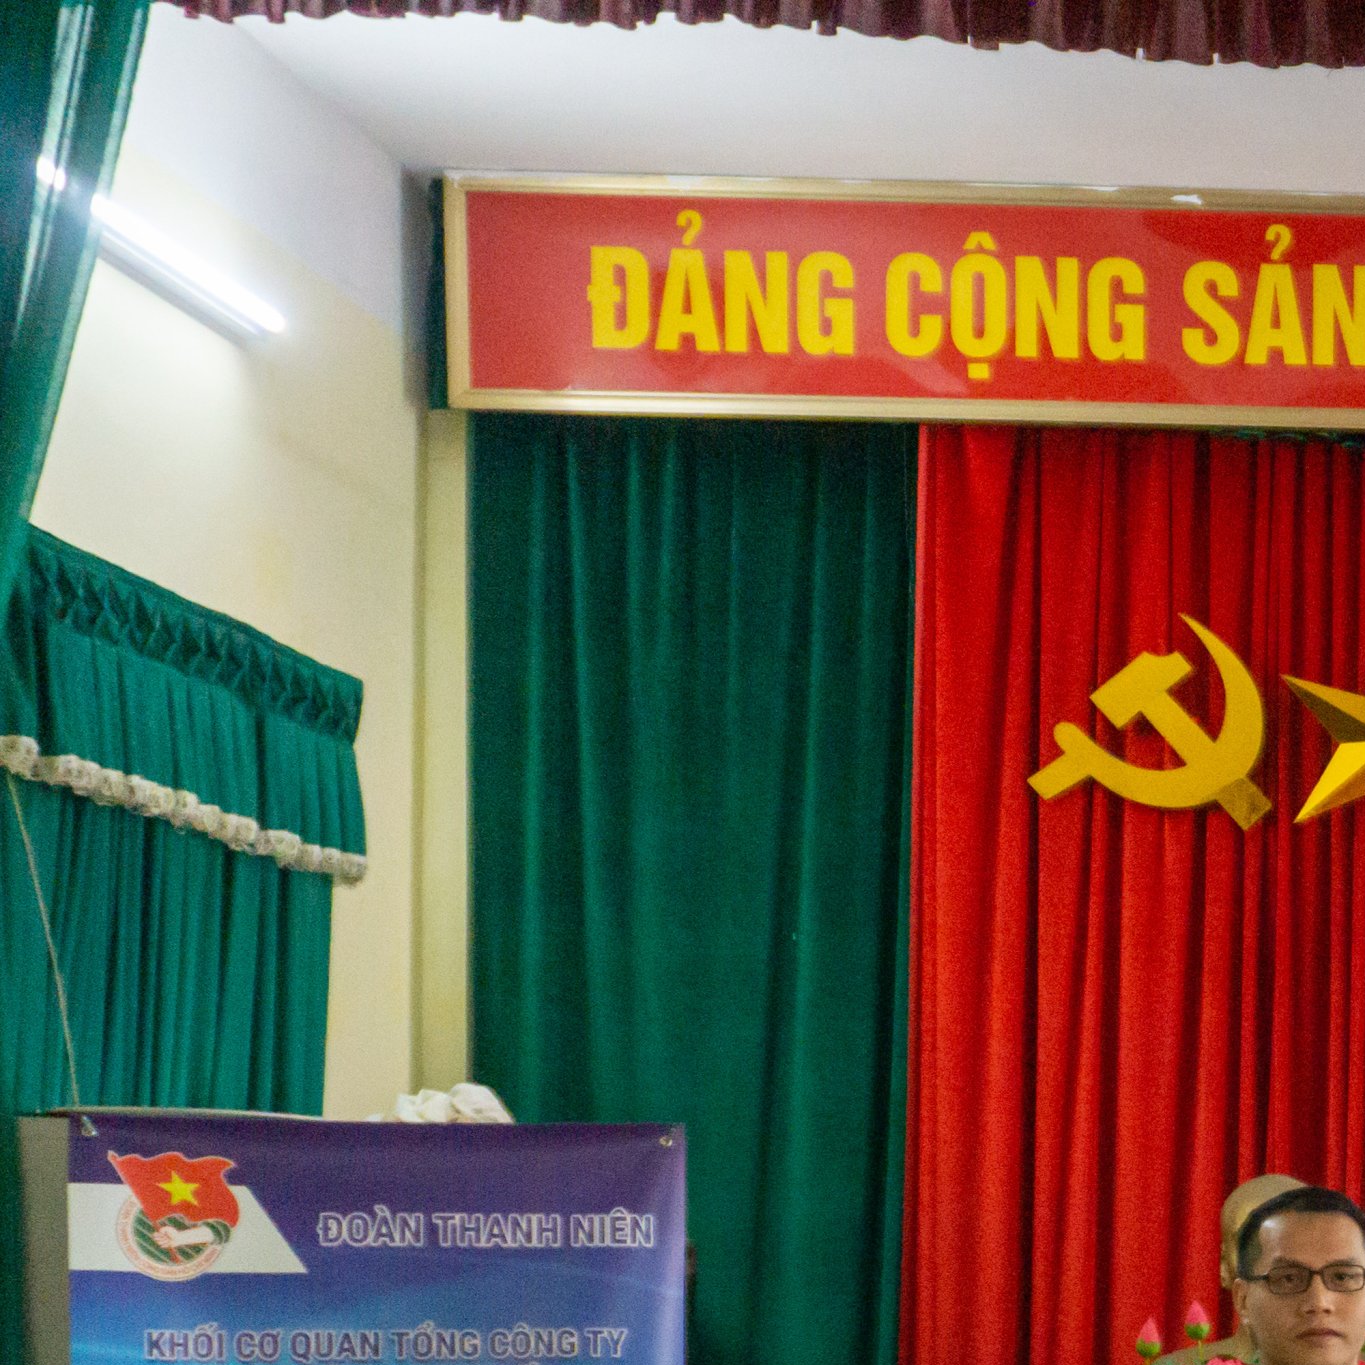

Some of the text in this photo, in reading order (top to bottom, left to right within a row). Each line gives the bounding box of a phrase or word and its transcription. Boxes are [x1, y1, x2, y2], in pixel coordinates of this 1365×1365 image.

[587, 211, 856, 356] ĐẢNG
[885, 232, 1147, 380] CỘNG
[317, 1205, 654, 1247] ĐOÀN THANH NIÊN
[145, 1320, 627, 1363] KHỐI CƠ QUAN TỔNG CÔNG TY
